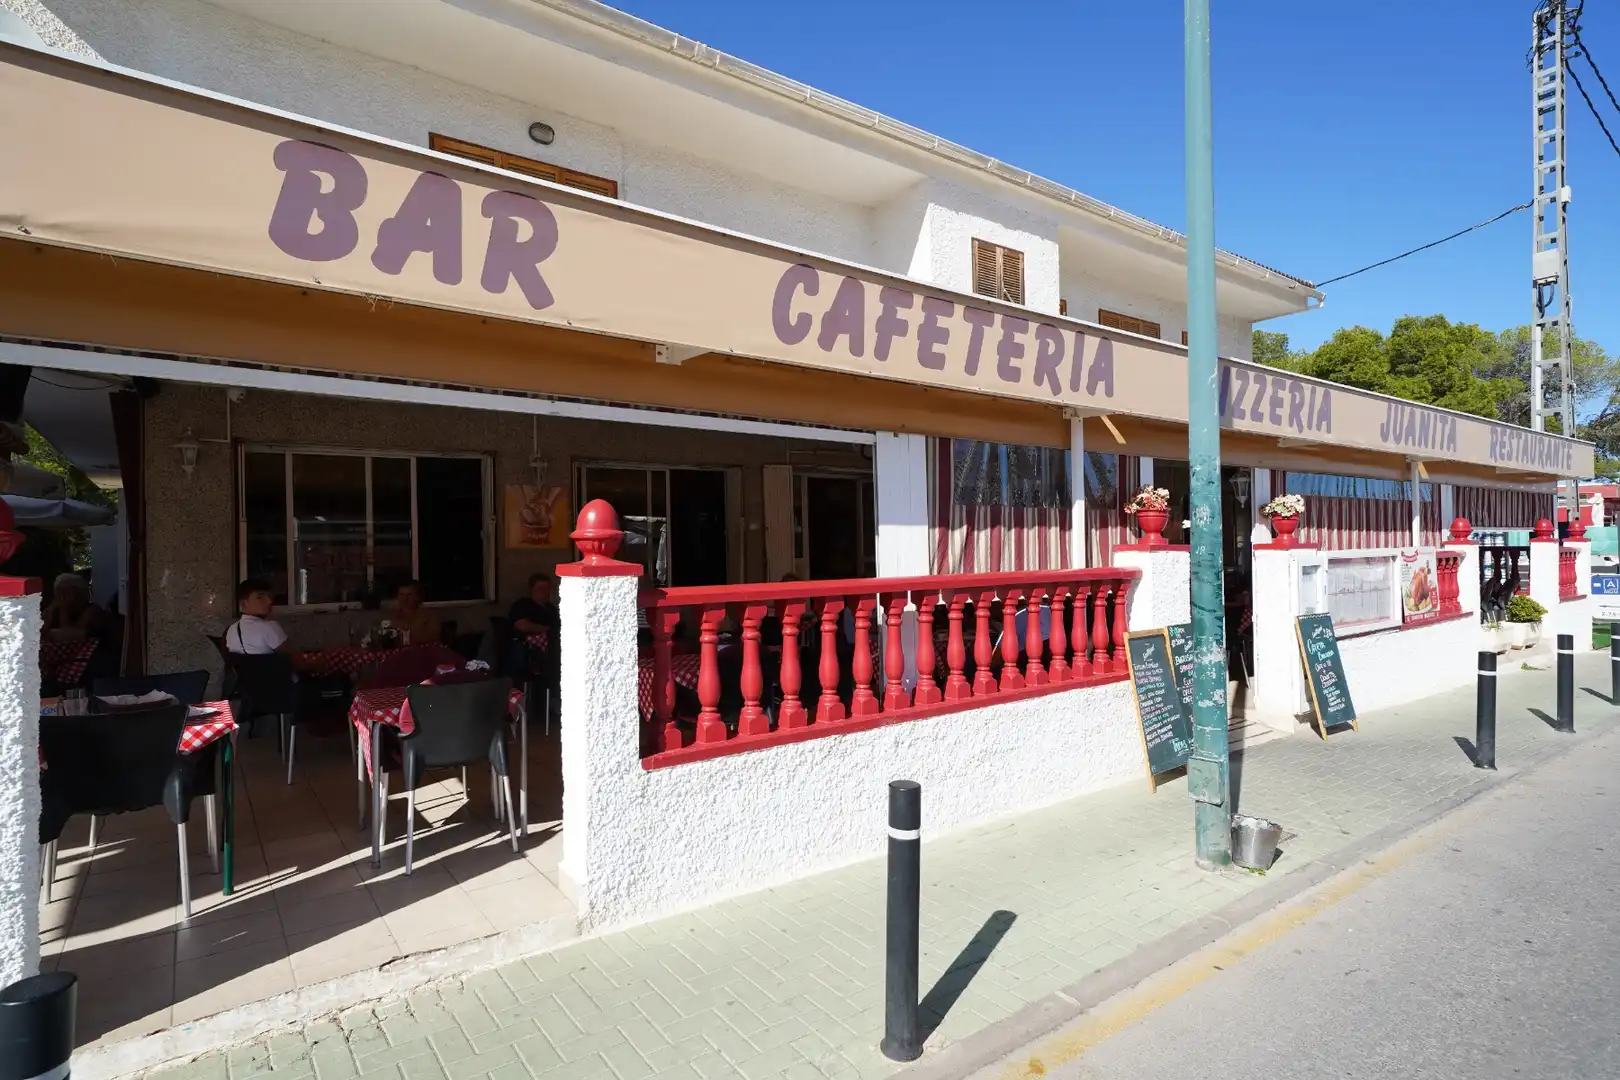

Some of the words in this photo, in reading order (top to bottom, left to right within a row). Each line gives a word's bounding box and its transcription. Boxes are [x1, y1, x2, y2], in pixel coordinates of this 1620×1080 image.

[268, 139, 559, 310] BAR
[772, 263, 1114, 398] CAFETERIA
[1218, 365, 1332, 434] IZZERIA
[1380, 402, 1457, 453] JUANITA
[1489, 425, 1573, 470] RESTAURANTE
